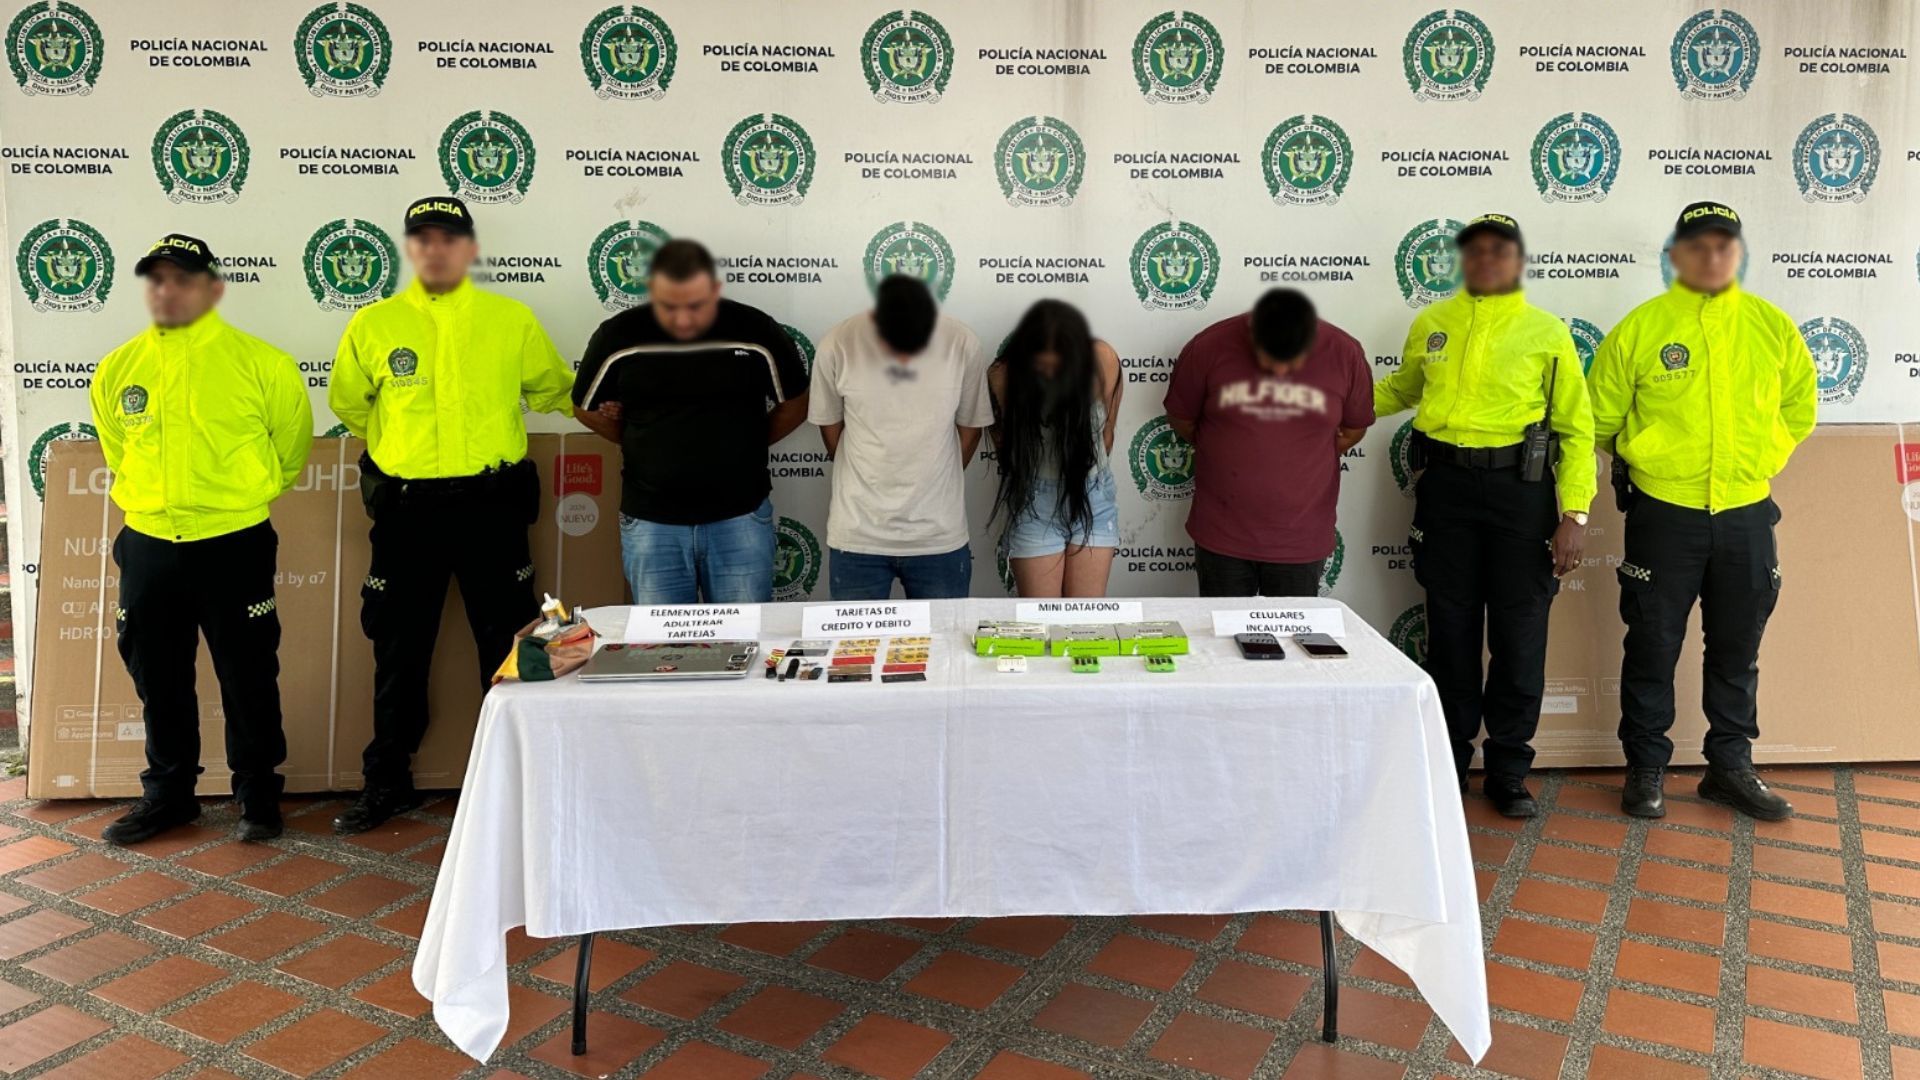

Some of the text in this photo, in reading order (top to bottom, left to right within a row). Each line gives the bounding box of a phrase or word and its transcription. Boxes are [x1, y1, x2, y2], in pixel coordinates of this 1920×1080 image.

[131, 38, 268, 51] POLICÍA NACIONAL
[419, 39, 554, 53] POLICÍA NACIONAL
[703, 43, 835, 57] POLICÍA NACIONAL
[1520, 44, 1646, 56] POLICÍA NACIONAL
[979, 47, 1107, 59] POLICÍA NACIONAL
[1249, 45, 1377, 58] POLICÍA NACIONAL
[1784, 45, 1906, 58] POLICÍA NACIONAL
[150, 56, 251, 67] DE COLOMBIA
[437, 57, 537, 68] DE COLOMBIA
[721, 61, 818, 72] DE COLOMBIA
[1536, 61, 1629, 72] DE COLOMBIA
[996, 65, 1090, 75] DE COLOMBIA
[1266, 63, 1360, 74] DE COLOMBIA
[1800, 63, 1890, 73] DE COLOMBIA
[2, 145, 129, 158] OLICÍA NACIONAL
[280, 146, 415, 159] POLICÍA NACIONAL
[566, 148, 699, 161] POLICÍA NACIONAL
[1114, 151, 1240, 163] POLICÍA NACIONAL
[1382, 149, 1509, 162] POLICÍA NACIONAL
[1649, 147, 1772, 160] POLICÍA NACIONAL
[845, 151, 973, 164] POLICÍA NACIONAL
[11, 163, 112, 174] DE COLOMBIA
[299, 164, 399, 174] DE COLOMBIA
[585, 166, 683, 177] DE COLOMBIA
[862, 168, 957, 179] DE COLOMBIA
[1131, 168, 1224, 178] DE COLOMBIA
[1398, 166, 1492, 176] DE COLOMBIA
[1664, 165, 1755, 175] DE COLOMBIA
[409, 202, 463, 218] POLICÍA
[214, 257, 277, 267] ACIONAL
[486, 257, 562, 267] NACIONAL
[716, 255, 838, 268] OLICÍA NACIONAL
[980, 256, 1105, 268] POLICÍA NACIONAL
[1244, 254, 1370, 267] POLICÍA NACIONAL
[1567, 254, 1636, 264] NACIONAL
[1772, 251, 1893, 263] POLICÍA NACIONAL
[726, 272, 822, 283] DE COLOMBIA
[996, 273, 1089, 283] DE COLOMBIA
[1260, 271, 1353, 281] DE COLOMBIA
[1548, 268, 1619, 279] COLOMBIA
[1787, 268, 1877, 278] DE COLOMBIA
[14, 360, 62, 373] OLICÍA
[1121, 355, 1164, 368] OLICÍA
[23, 378, 43, 388] DE
[309, 377, 328, 387] DE
[1129, 373, 1147, 382] DE
[772, 467, 824, 477] LOMBIA
[68, 467, 111, 495] LG
[1372, 546, 1414, 556] POLIC
[1128, 562, 1195, 571] DE COLOM
[1388, 560, 1406, 569] DE
[288, 572, 304, 588] by
[650, 607, 740, 617] ELEMENTOS PARA
[835, 606, 897, 617] TARJETAS DE
[1038, 602, 1119, 612] MINI DATAFONO
[1249, 611, 1305, 620] CELULARES
[663, 619, 723, 628] ADULTERAR
[821, 619, 911, 631] CREDITO Y DEBITO
[1246, 624, 1312, 633] INCAUTADOS
[667, 629, 716, 638] TARTEJAS
